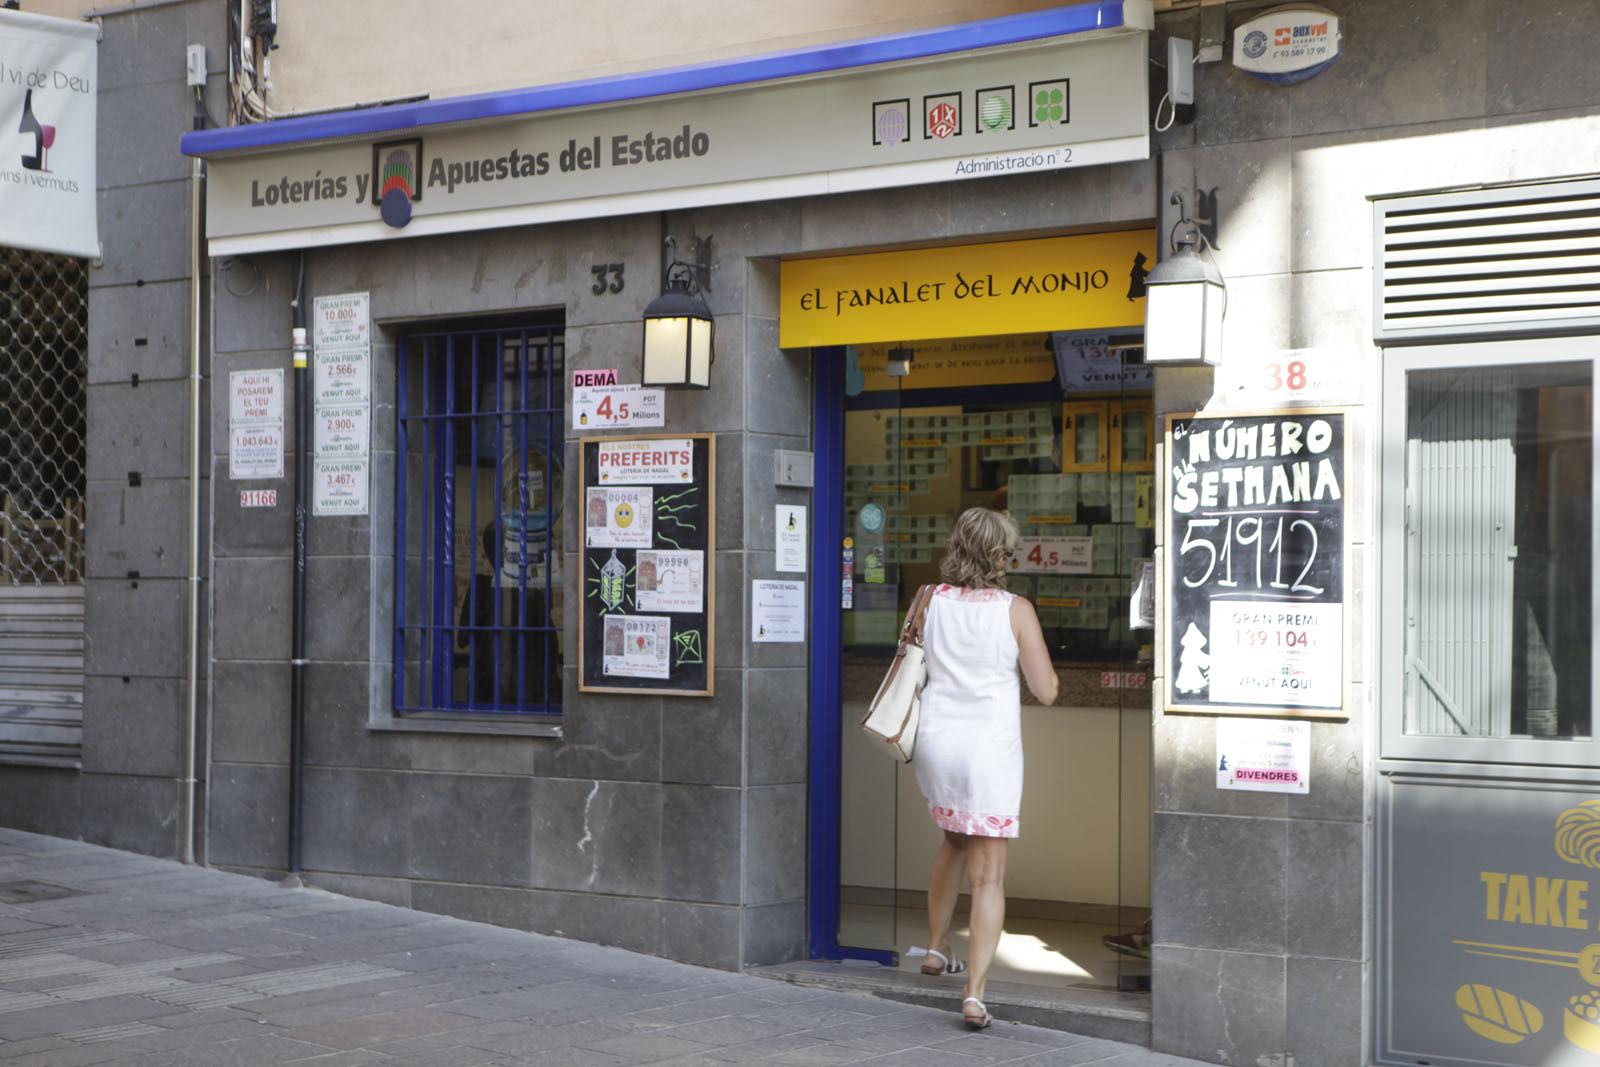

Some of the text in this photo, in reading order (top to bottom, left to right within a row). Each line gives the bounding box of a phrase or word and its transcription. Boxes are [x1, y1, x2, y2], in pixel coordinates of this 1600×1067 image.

[1292, 21, 1328, 38] auxvyd
[9, 69, 22, 85] vi
[26, 69, 47, 89] de
[53, 71, 90, 94] Deu
[1063, 148, 1073, 164] 2
[251, 124, 711, 208] Loterías y Apuestas del Estado
[30, 175, 79, 193] vermuts
[591, 262, 625, 296] 33
[319, 299, 361, 310] GRAN PREMI
[321, 335, 343, 344] VENUT
[321, 353, 363, 365] GRAN PREMI
[574, 369, 616, 387] DEMÀ
[238, 386, 273, 396] POSAREM
[321, 390, 343, 398] VENUT
[243, 397, 269, 408] EL TEU
[245, 407, 268, 417] PREMI
[321, 408, 362, 418] GRAN PREMI
[632, 410, 660, 420] Milions
[321, 444, 343, 453] VENUT
[600, 450, 690, 467] PREFERITS
[321, 463, 362, 473] GRAN PREMI
[1173, 456, 1342, 514] SETMANA
[241, 492, 277, 507] 91166
[320, 498, 341, 507] VENUT
[1179, 515, 1325, 595] 51912
[1277, 613, 1319, 627] PREMI
[1236, 769, 1298, 782] DIVENDRES
[1480, 871, 1589, 931] TAKE
